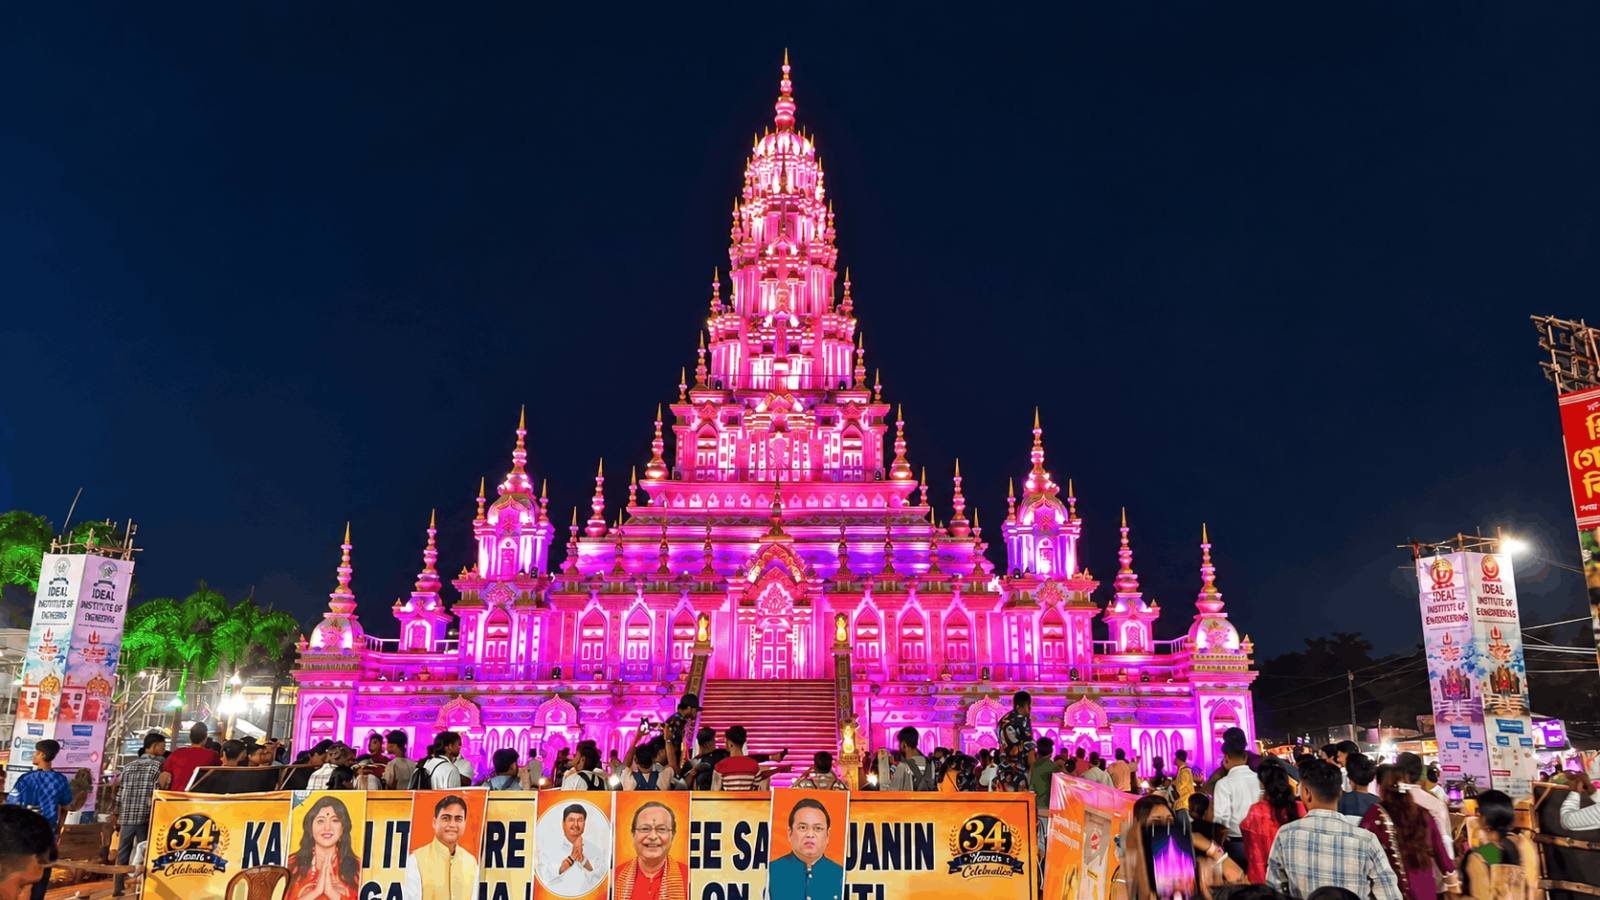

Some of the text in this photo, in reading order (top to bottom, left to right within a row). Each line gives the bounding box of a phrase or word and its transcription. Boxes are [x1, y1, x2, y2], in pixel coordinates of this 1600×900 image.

[48, 586, 68, 597] IDEAL
[92, 589, 115, 601] IDEAL
[1482, 583, 1504, 595] IDEAL
[1433, 589, 1456, 602] IDEAL
[241, 821, 283, 868] KA
[481, 821, 527, 869] RE
[690, 821, 722, 869] EE
[732, 820, 769, 871] SA
[845, 822, 935, 871] JANIN
